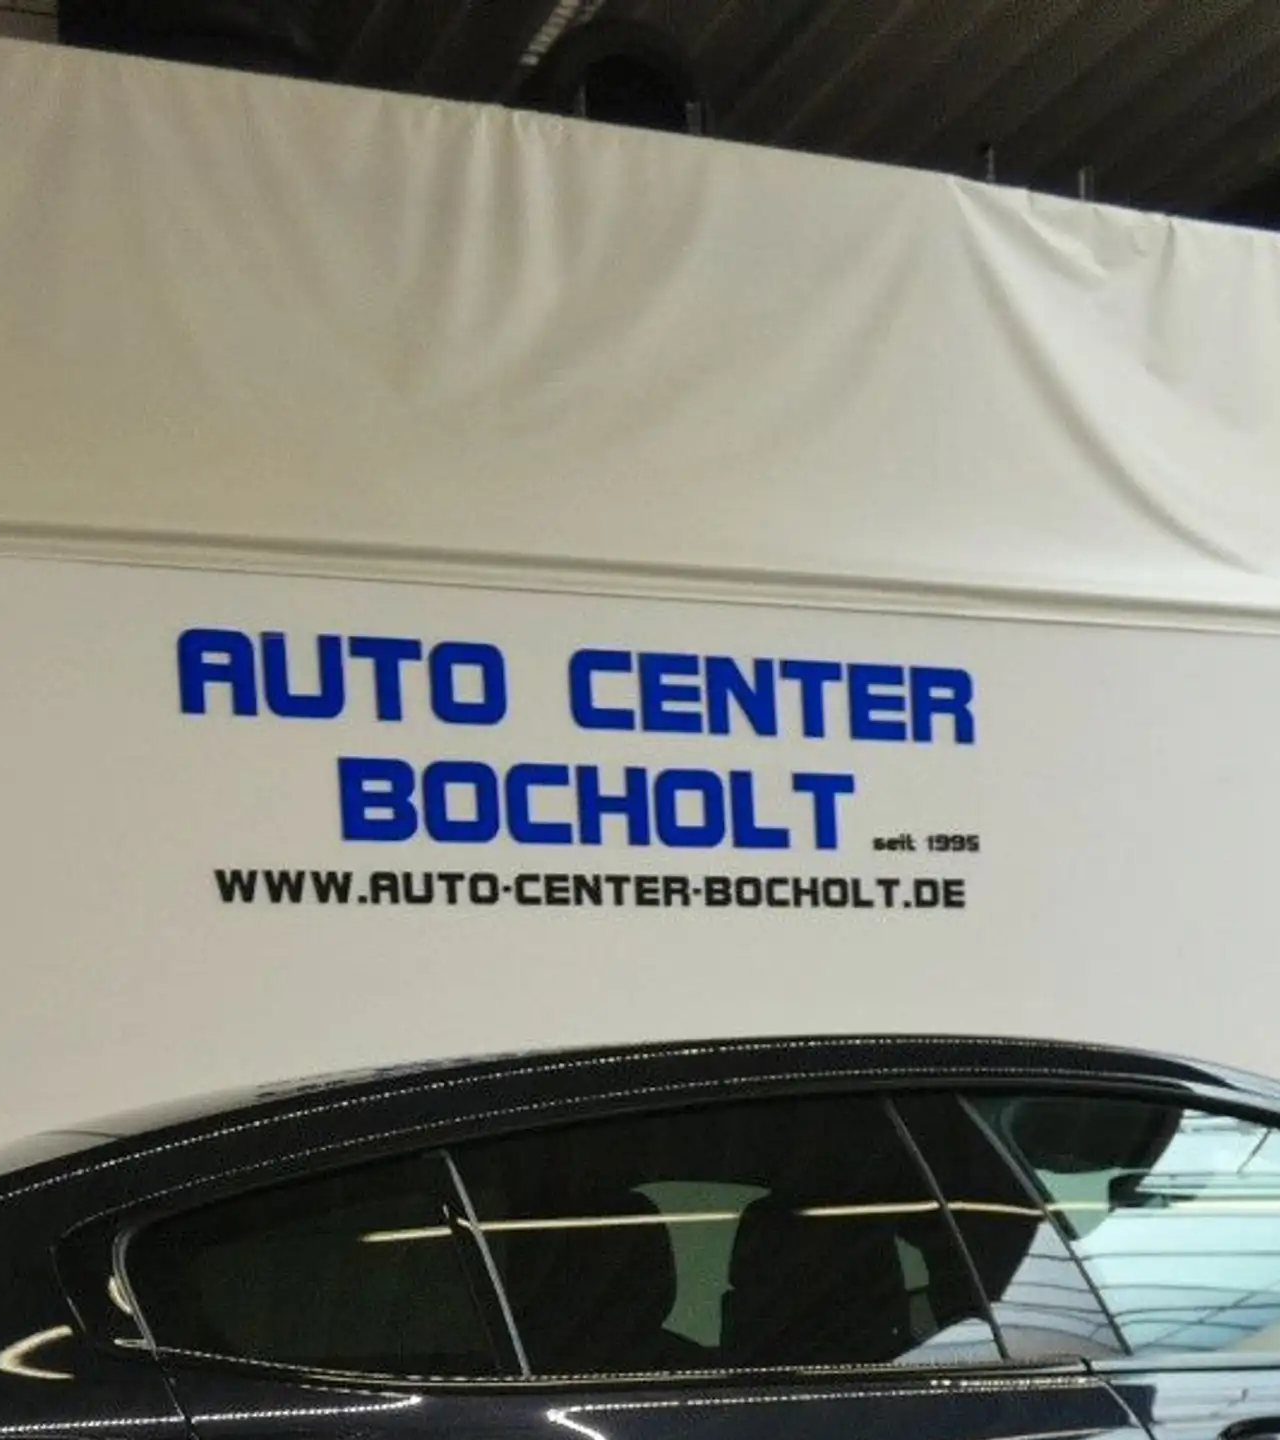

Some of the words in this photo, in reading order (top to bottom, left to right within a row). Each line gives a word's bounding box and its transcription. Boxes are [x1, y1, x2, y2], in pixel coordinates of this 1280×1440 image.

[177, 627, 510, 726] AUTO
[569, 648, 977, 745] CENTER
[336, 756, 857, 851] BOCHOLT
[873, 833, 917, 852] seit
[927, 833, 980, 852] 1995
[214, 868, 966, 909] WWW.AUTO-CENTER-BOCHOLT.DE
